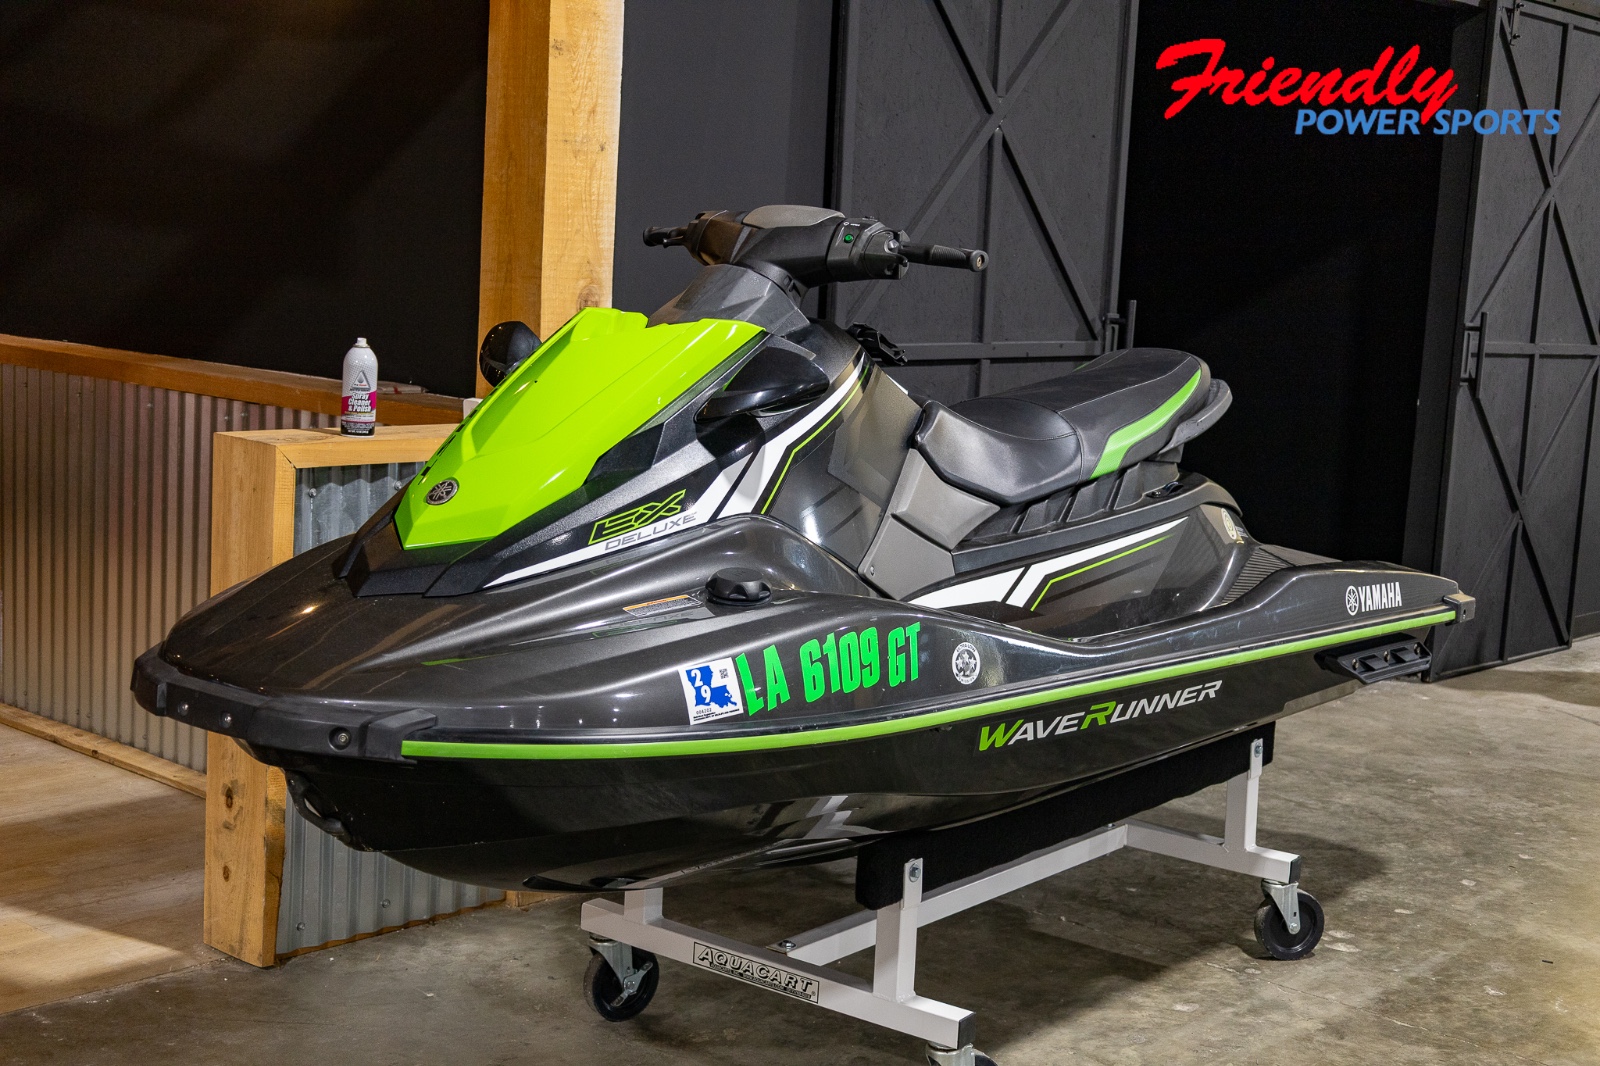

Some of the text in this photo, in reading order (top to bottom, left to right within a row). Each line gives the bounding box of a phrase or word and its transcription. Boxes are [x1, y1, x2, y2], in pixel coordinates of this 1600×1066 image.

[348, 398, 371, 406] Cleaner
[352, 392, 369, 400] Spray
[588, 488, 687, 545] EX
[605, 512, 697, 551] DELUXE
[1358, 581, 1403, 612] YAMAHA
[690, 669, 704, 688] 2
[735, 621, 921, 716] LA 6109 GT
[700, 684, 711, 704] 9
[979, 680, 1223, 751] WAVERUNNER
[698, 946, 812, 993] AQUACART
